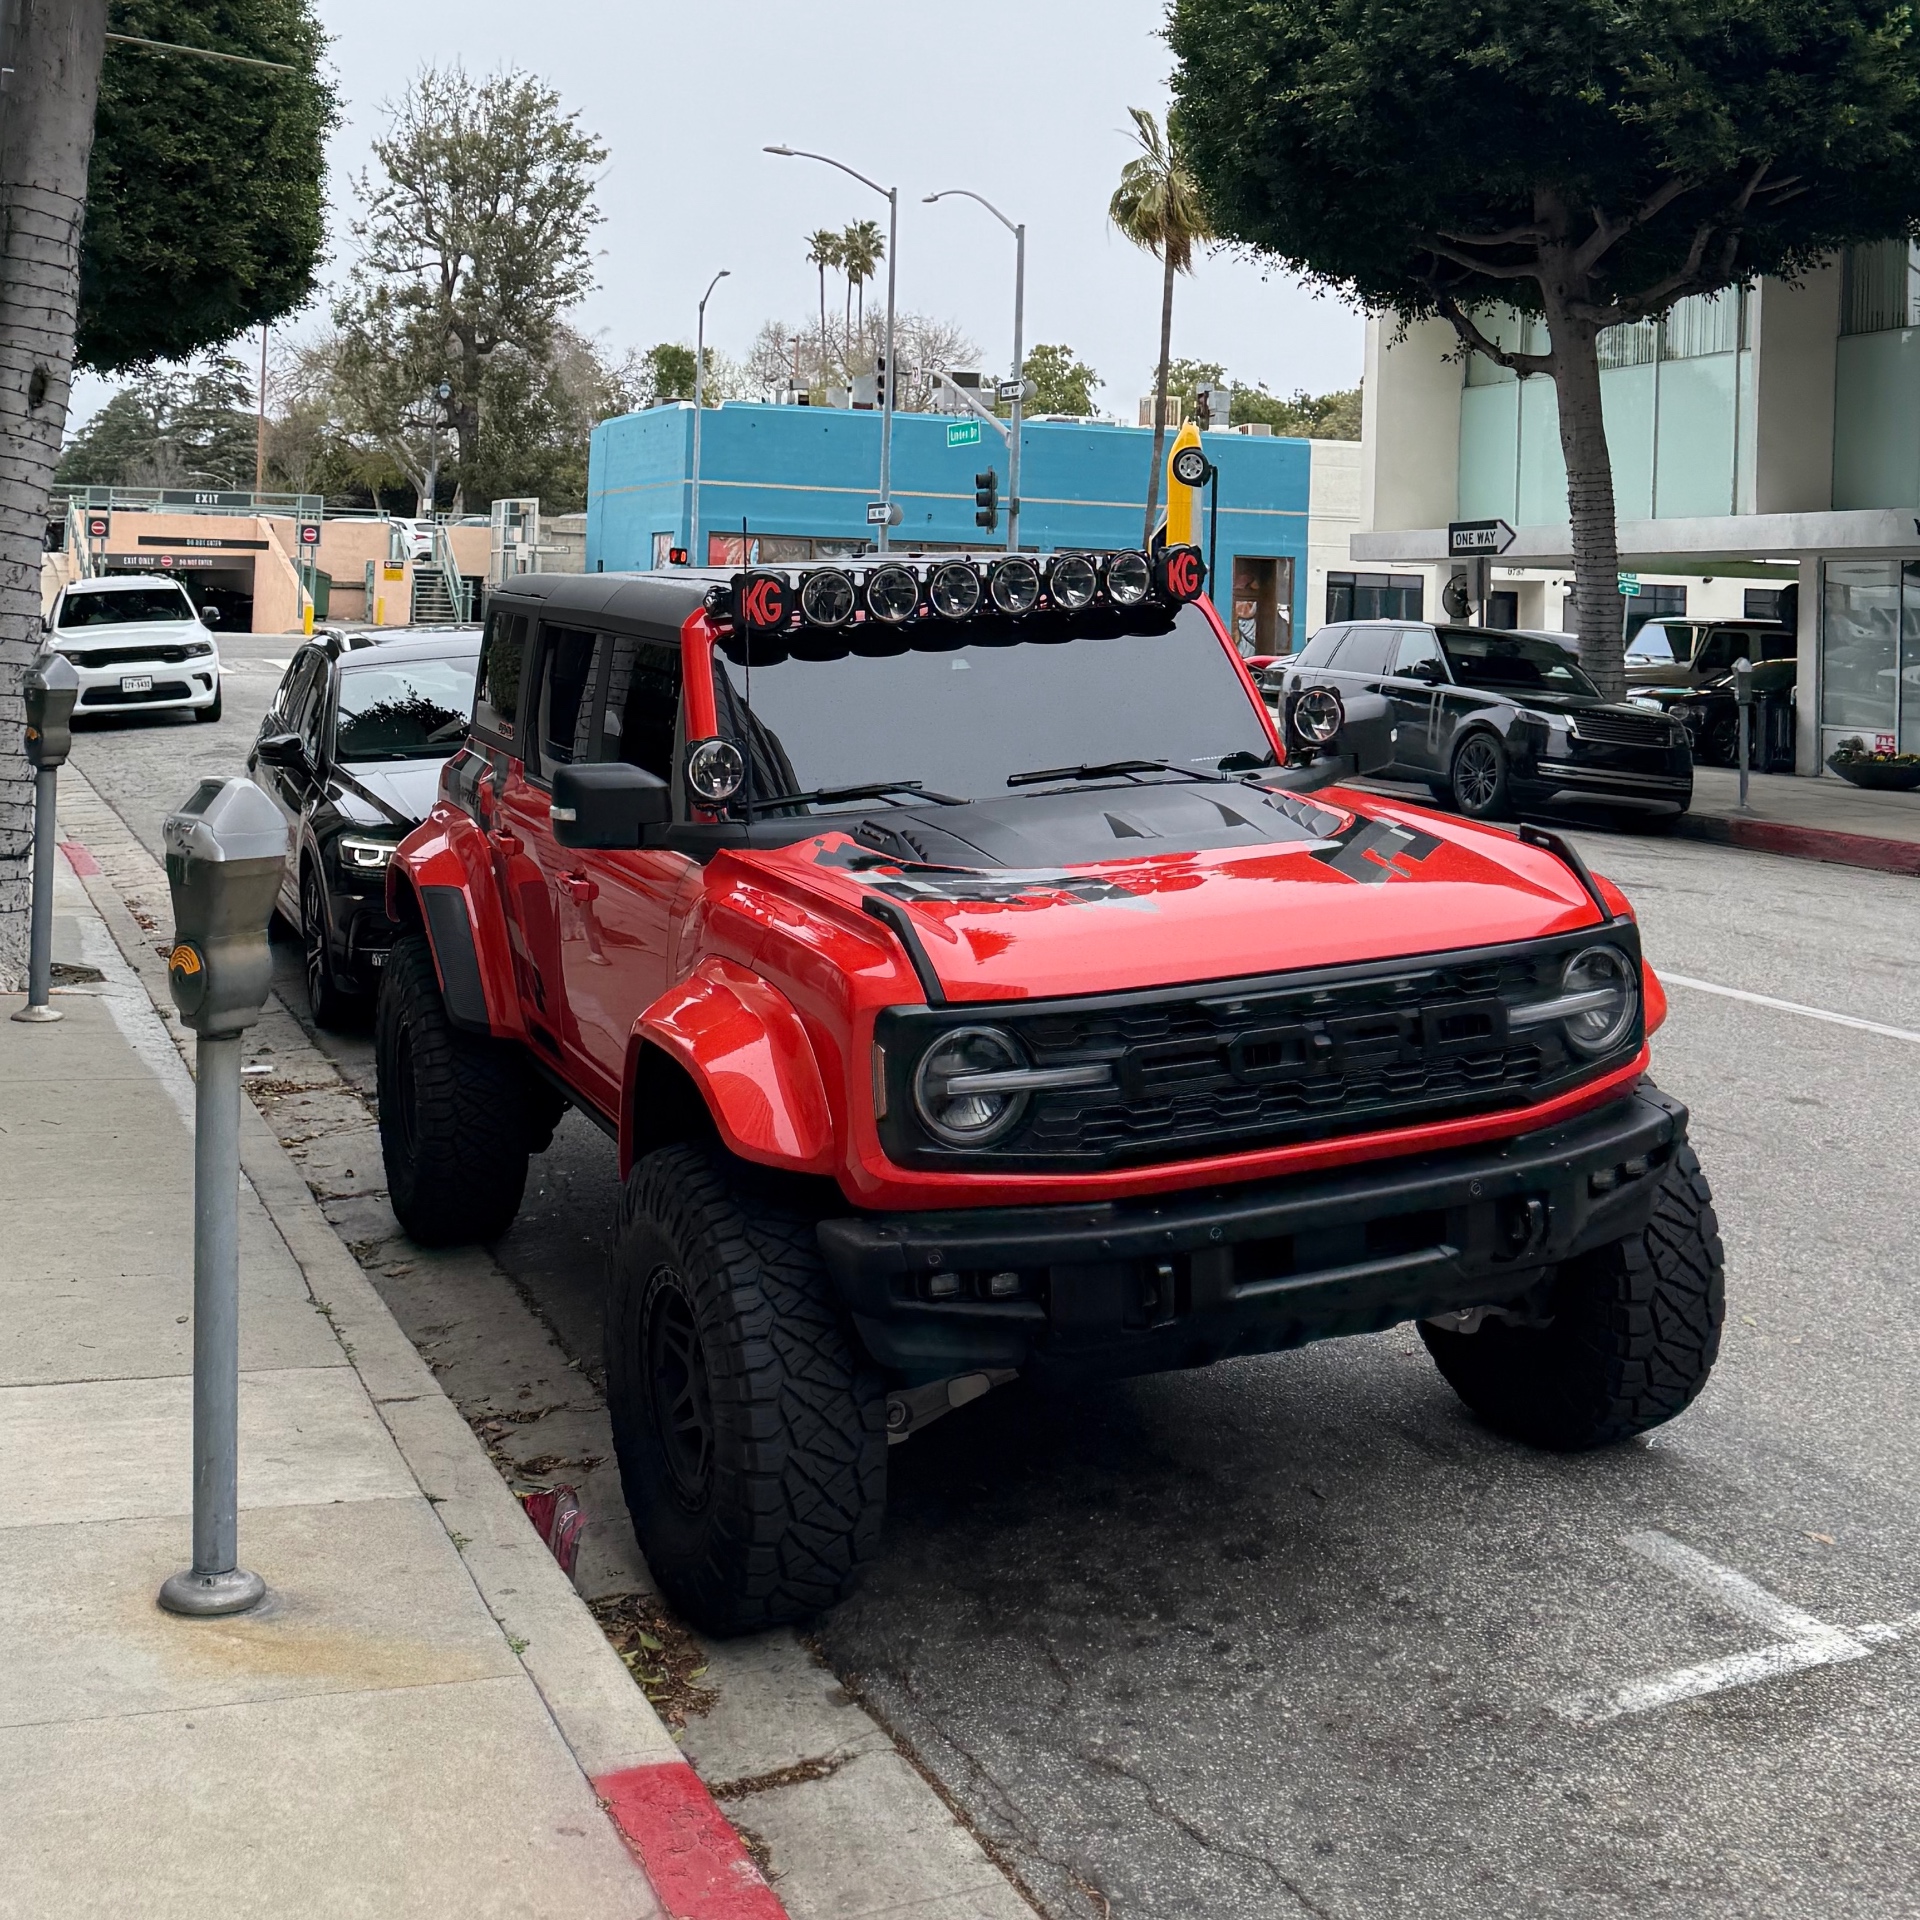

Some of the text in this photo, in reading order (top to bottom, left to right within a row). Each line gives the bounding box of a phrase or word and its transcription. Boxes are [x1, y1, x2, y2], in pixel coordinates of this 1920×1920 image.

[194, 493, 219, 504] EXIT
[1455, 530, 1496, 546] ONE WAY
[123, 556, 155, 565] EXIT ONLY
